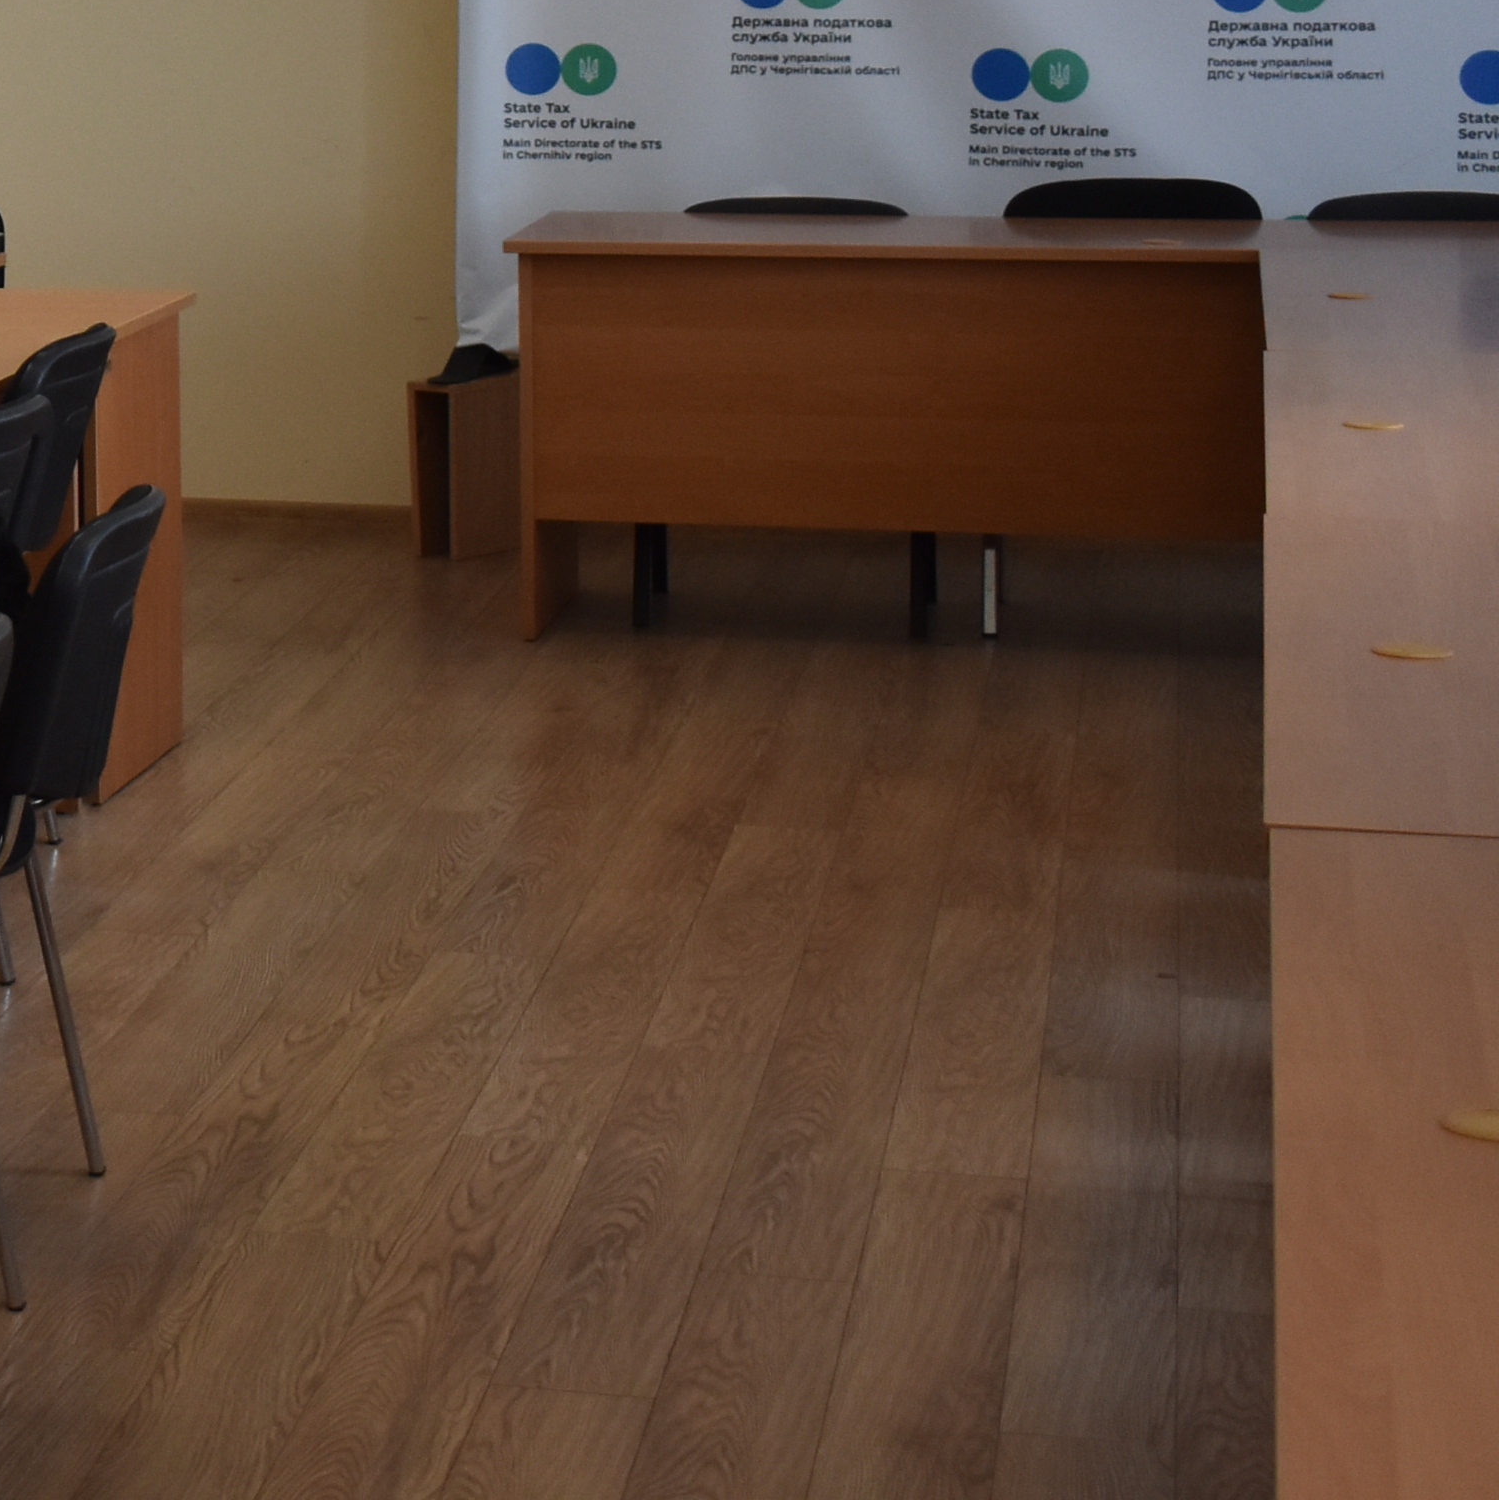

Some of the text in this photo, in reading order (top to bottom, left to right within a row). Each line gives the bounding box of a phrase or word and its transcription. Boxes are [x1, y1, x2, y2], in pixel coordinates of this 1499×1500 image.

[731, 16, 892, 29] Державна податкова
[732, 31, 852, 45] служба України
[731, 53, 851, 63] Головне управління
[730, 63, 900, 76] ДПС у Чернігівській області
[504, 102, 570, 114] State Tax
[504, 117, 636, 130] Service of Ukraine
[1458, 112, 1499, 124] State
[1458, 128, 1499, 139] Servi
[503, 139, 662, 150] Main Directorate of the STS
[503, 150, 612, 162] in Chernihiv region
[1457, 151, 1488, 160] Main
[1457, 163, 1469, 172] in
